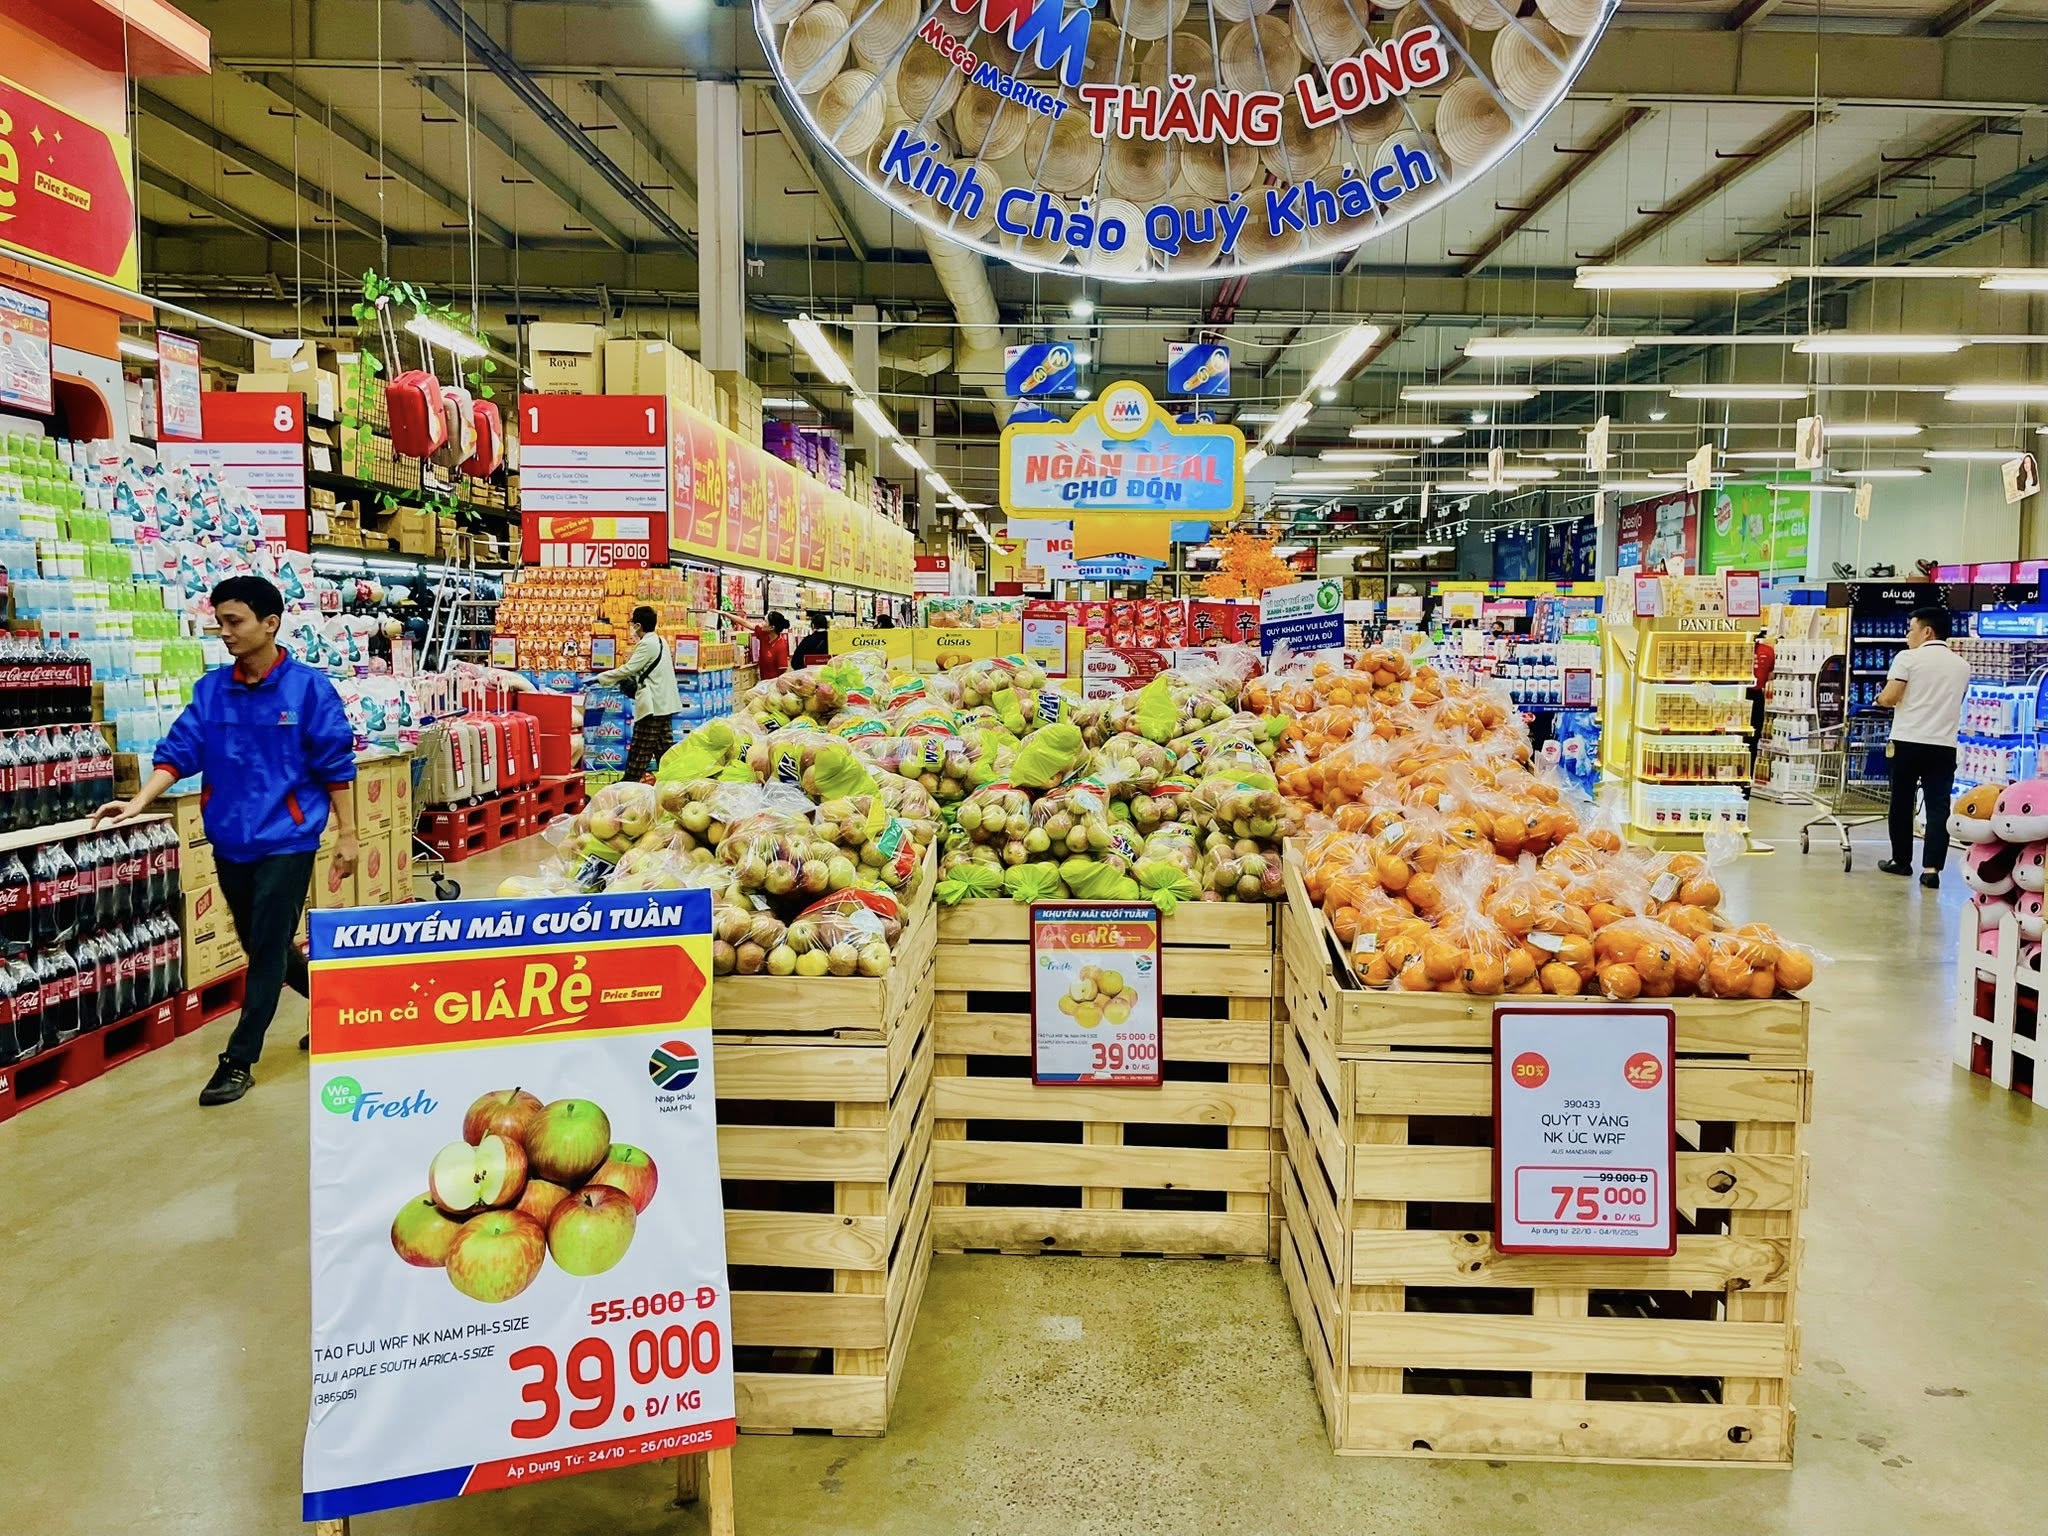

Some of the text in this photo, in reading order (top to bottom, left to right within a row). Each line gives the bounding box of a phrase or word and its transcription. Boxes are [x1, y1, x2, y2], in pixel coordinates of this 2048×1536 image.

[1081, 27, 1445, 144] THĂNG LONG
[36, 174, 89, 208] Price Saver
[879, 129, 1437, 256] Kính Chào Quý Khách
[549, 357, 577, 369] Royal
[273, 405, 294, 432] 8
[528, 406, 539, 433] 1
[645, 407, 656, 434] 1
[1025, 449, 1224, 485] NGÀN DEAL
[1062, 474, 1182, 501] CHỜ ĐÓN
[1047, 539, 1073, 553] NG
[935, 559, 947, 569] 13
[1882, 588, 1916, 600] DẦU GỘI
[1193, 610, 1215, 641] 辛
[1236, 611, 1258, 642] 辛
[1266, 620, 1338, 637] QUÝ KHÁCH VUI LÒNG
[1678, 618, 1741, 631] PANTENE
[851, 637, 887, 648] Custas
[937, 636, 971, 647] Custas
[1304, 634, 1320, 642] VỪA
[1322, 631, 1333, 640] ĐỦ
[1820, 692, 1834, 703] 10X
[1042, 909, 1149, 918] KHUYẾN MÃI CUỐI TUẦN
[333, 897, 684, 949] KHUYẾN MÃI CUỐI TUẦN
[603, 988, 660, 1002] Price Saver
[339, 1006, 383, 1026] Hơn
[389, 1001, 418, 1021] cả
[1628, 1060, 1659, 1080] x2
[327, 1085, 350, 1097] We
[655, 1092, 696, 1105] Nhập khẩu
[333, 1088, 439, 1123] are Fresh
[659, 1103, 693, 1114] NAM PHI
[1563, 1100, 1601, 1109] 390433
[1541, 1111, 1629, 1127] QUÝT VÀNG
[1544, 1131, 1563, 1143] NK
[1593, 1132, 1626, 1145] WRF
[1600, 1172, 1637, 1183] 99.000
[1628, 1214, 1641, 1222] KG
[1571, 1227, 1592, 1235] 22/10
[590, 1286, 717, 1326] 55.000 Đ
[314, 1316, 530, 1362] TÁO FUJI WRF NK NAM PHI-S.SIZE
[314, 1371, 338, 1385] FUJI
[341, 1363, 376, 1380] APPLE
[380, 1358, 417, 1374] SOUTH
[314, 1389, 357, 1406] (386505)
[676, 1390, 701, 1412] KG
[507, 1463, 525, 1478] Áp
[529, 1460, 561, 1474] Dụng
[588, 1446, 625, 1463] 24/10
[640, 1429, 713, 1454] 26/10/2025
